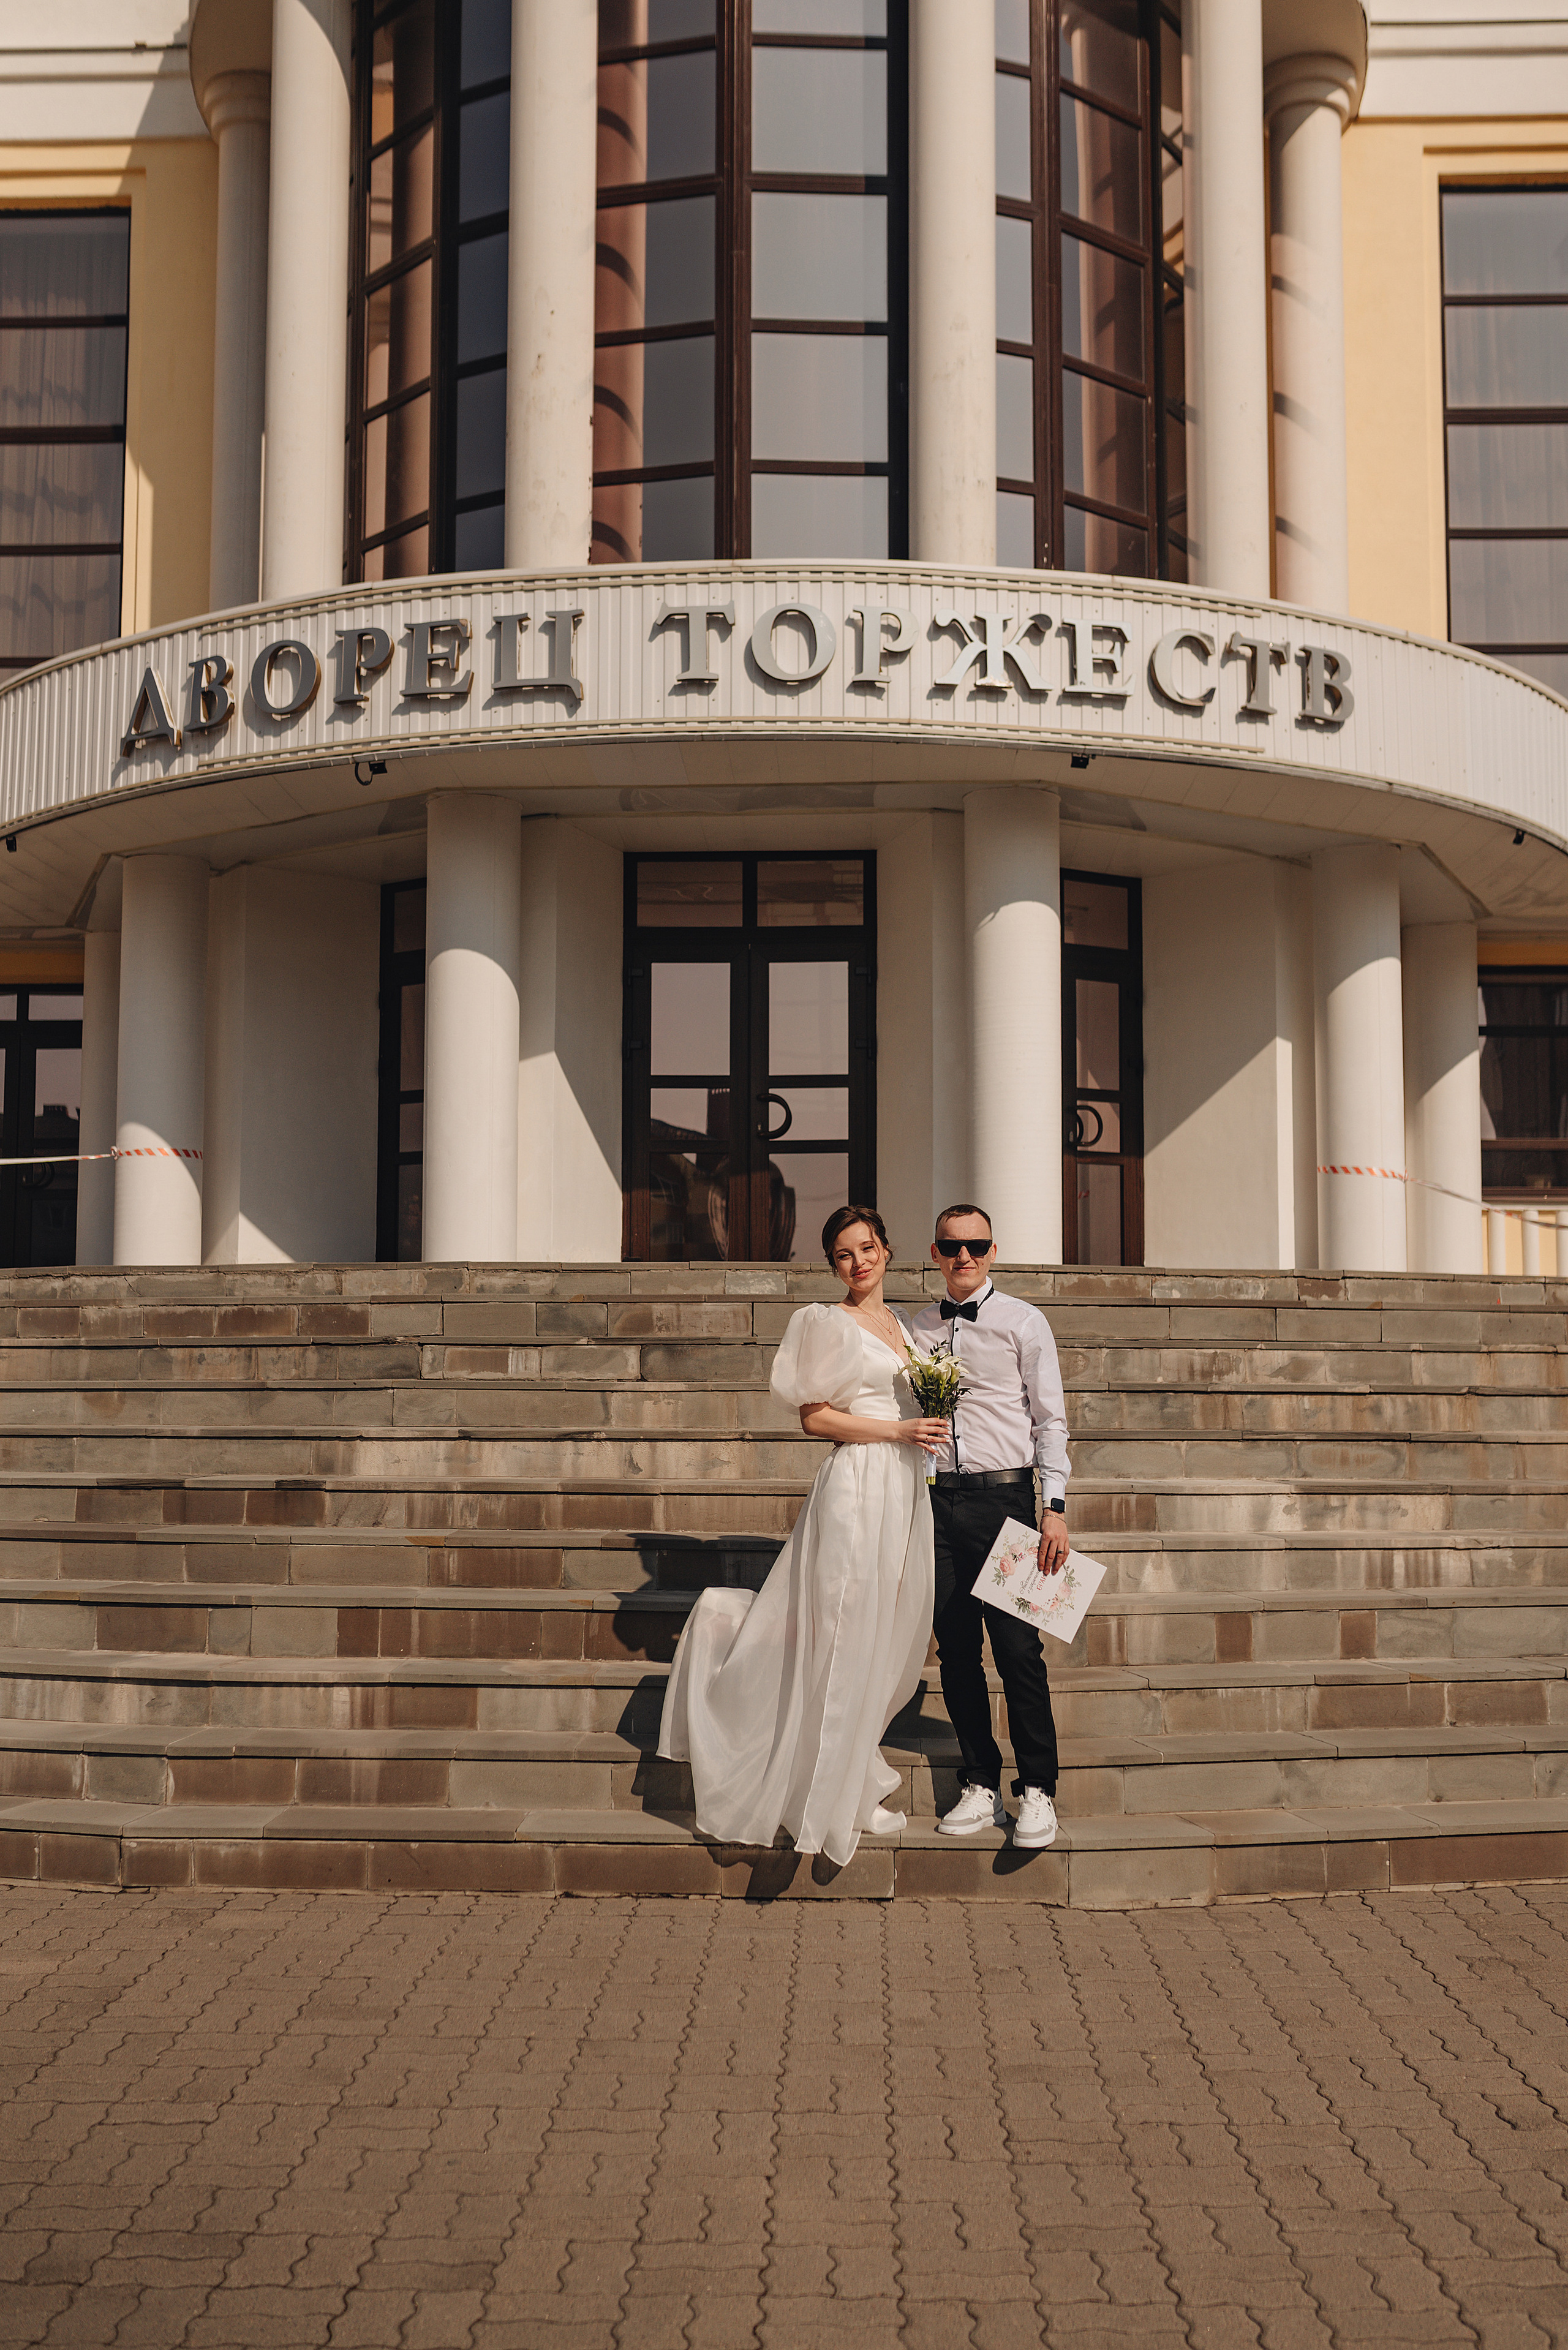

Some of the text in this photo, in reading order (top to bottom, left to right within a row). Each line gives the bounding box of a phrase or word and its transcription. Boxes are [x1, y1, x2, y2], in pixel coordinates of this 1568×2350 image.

[120, 600, 1355, 758] ДВОРЕЦ ТОРЖЕСТВ
[1036, 1575, 1047, 1591] БРАК
